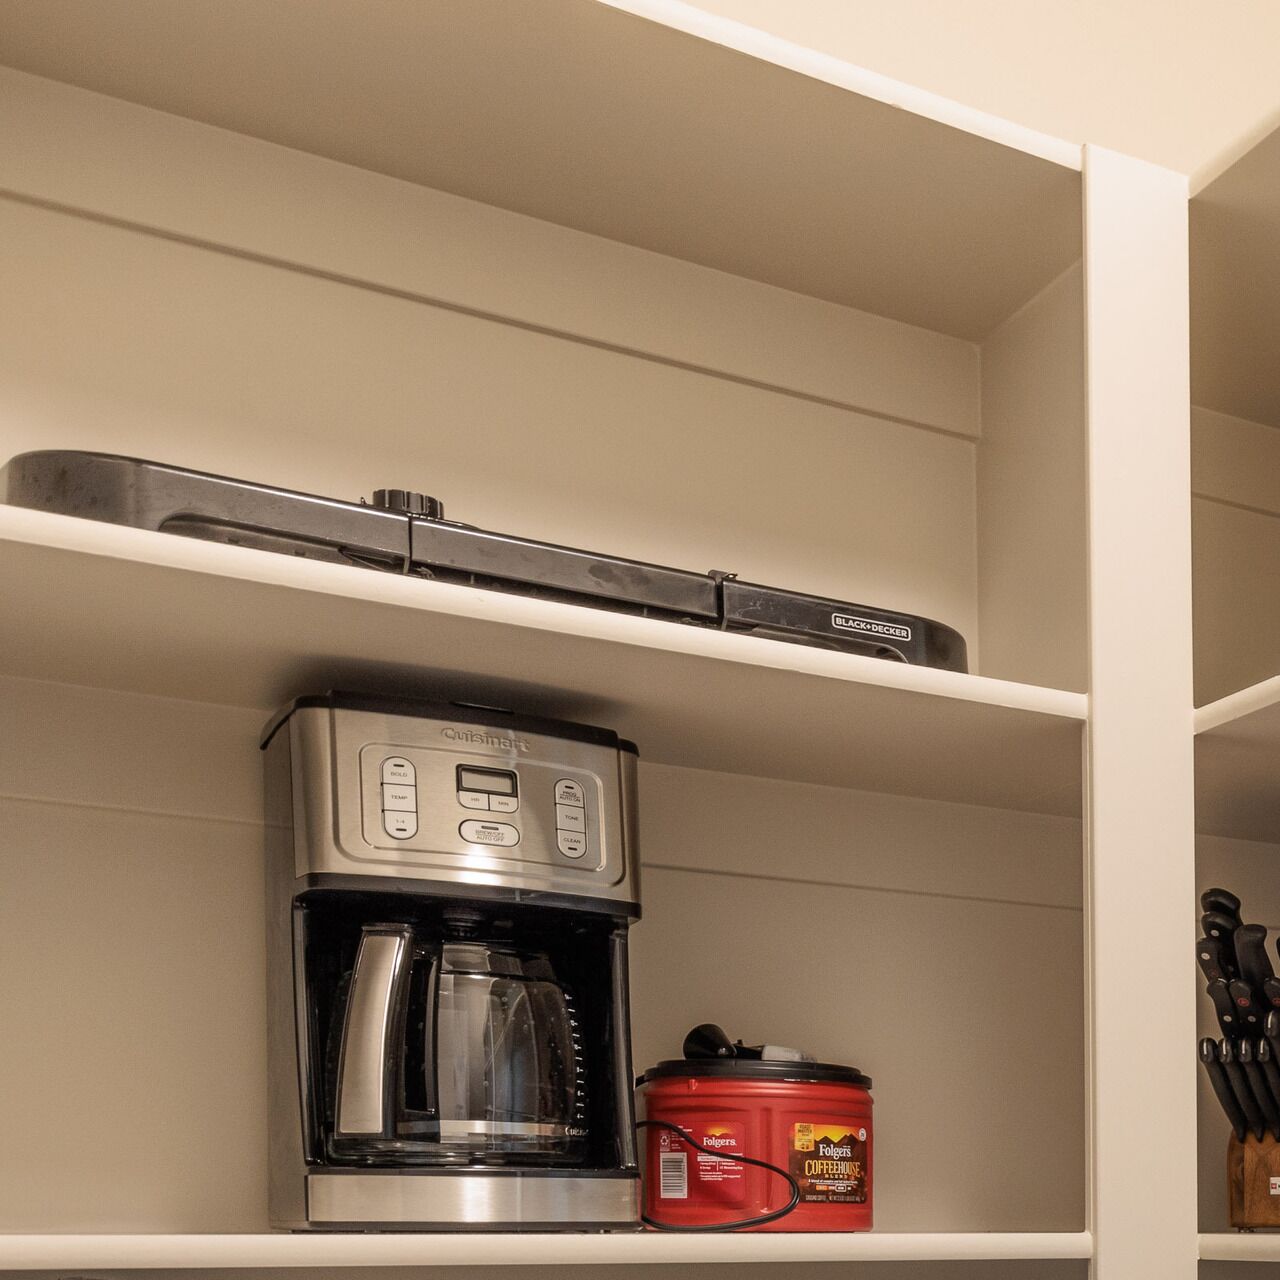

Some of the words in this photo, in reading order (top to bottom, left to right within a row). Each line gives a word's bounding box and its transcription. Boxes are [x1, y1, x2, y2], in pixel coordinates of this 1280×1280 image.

[835, 617, 908, 638] BLACK+DECKER
[441, 727, 531, 752] Cuisinart
[703, 1136, 737, 1148] Folgers
[819, 1143, 851, 1160] Folgers
[805, 1159, 860, 1177] COFFEEHOUSE
